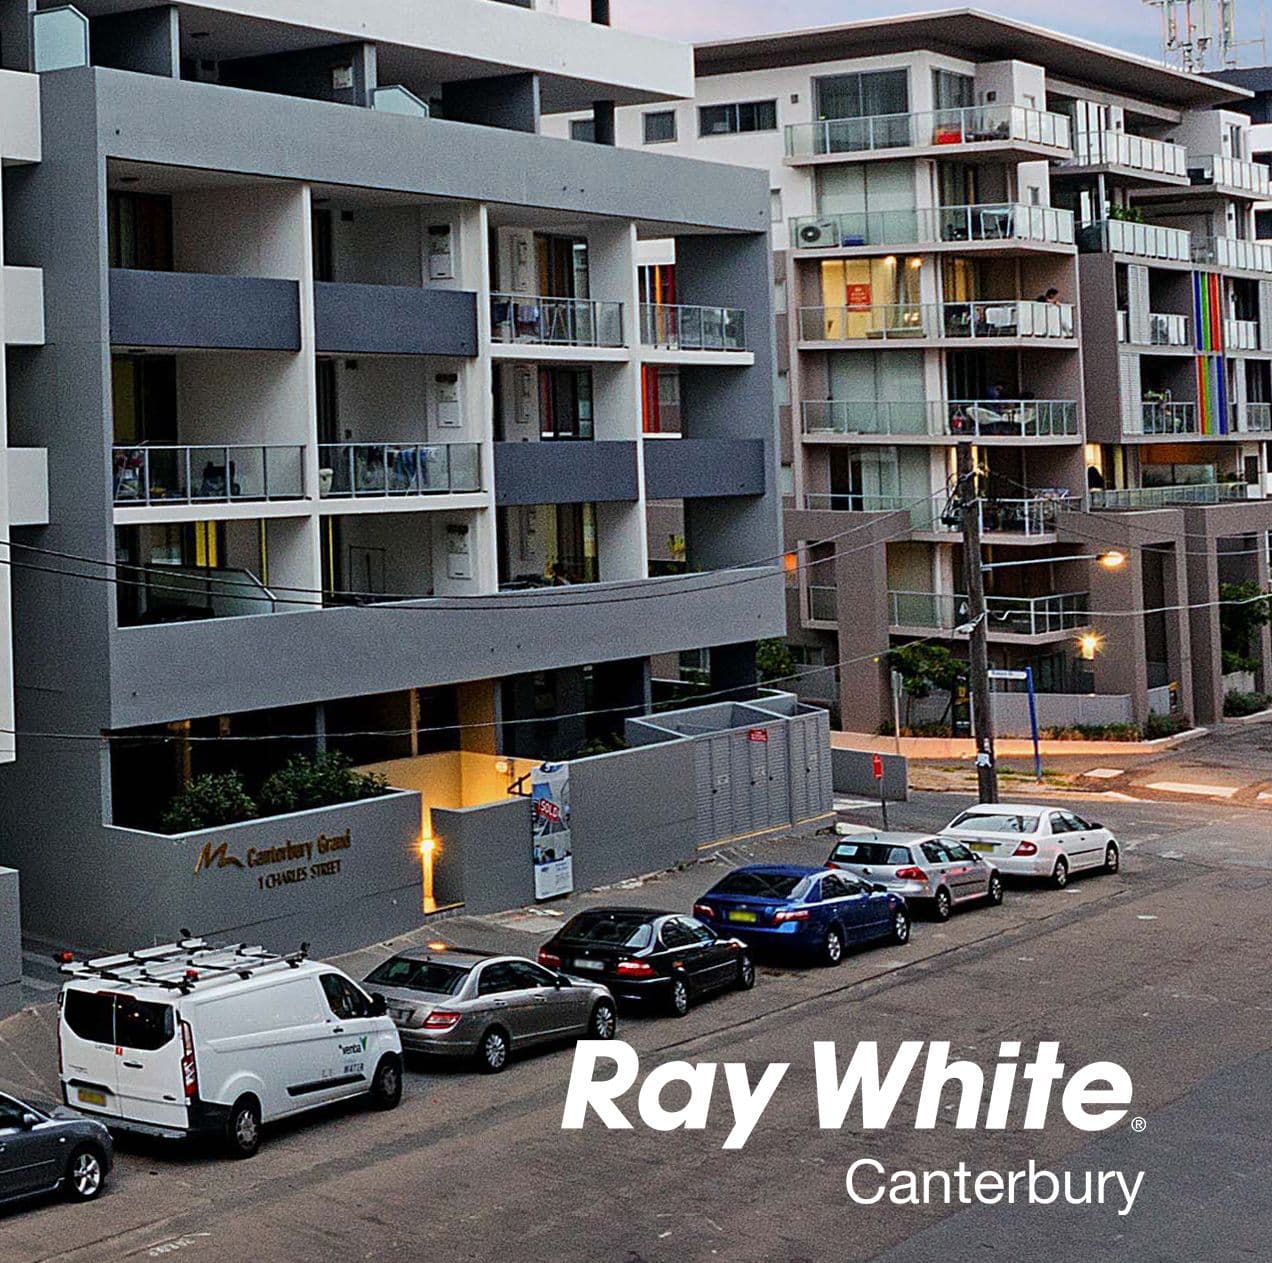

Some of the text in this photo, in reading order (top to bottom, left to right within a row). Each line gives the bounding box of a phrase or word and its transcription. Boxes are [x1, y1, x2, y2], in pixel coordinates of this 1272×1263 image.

[541, 800, 559, 817] SOLD
[247, 828, 351, 868] Canterbury Grand
[257, 859, 341, 889] 1 CHARLES STREET
